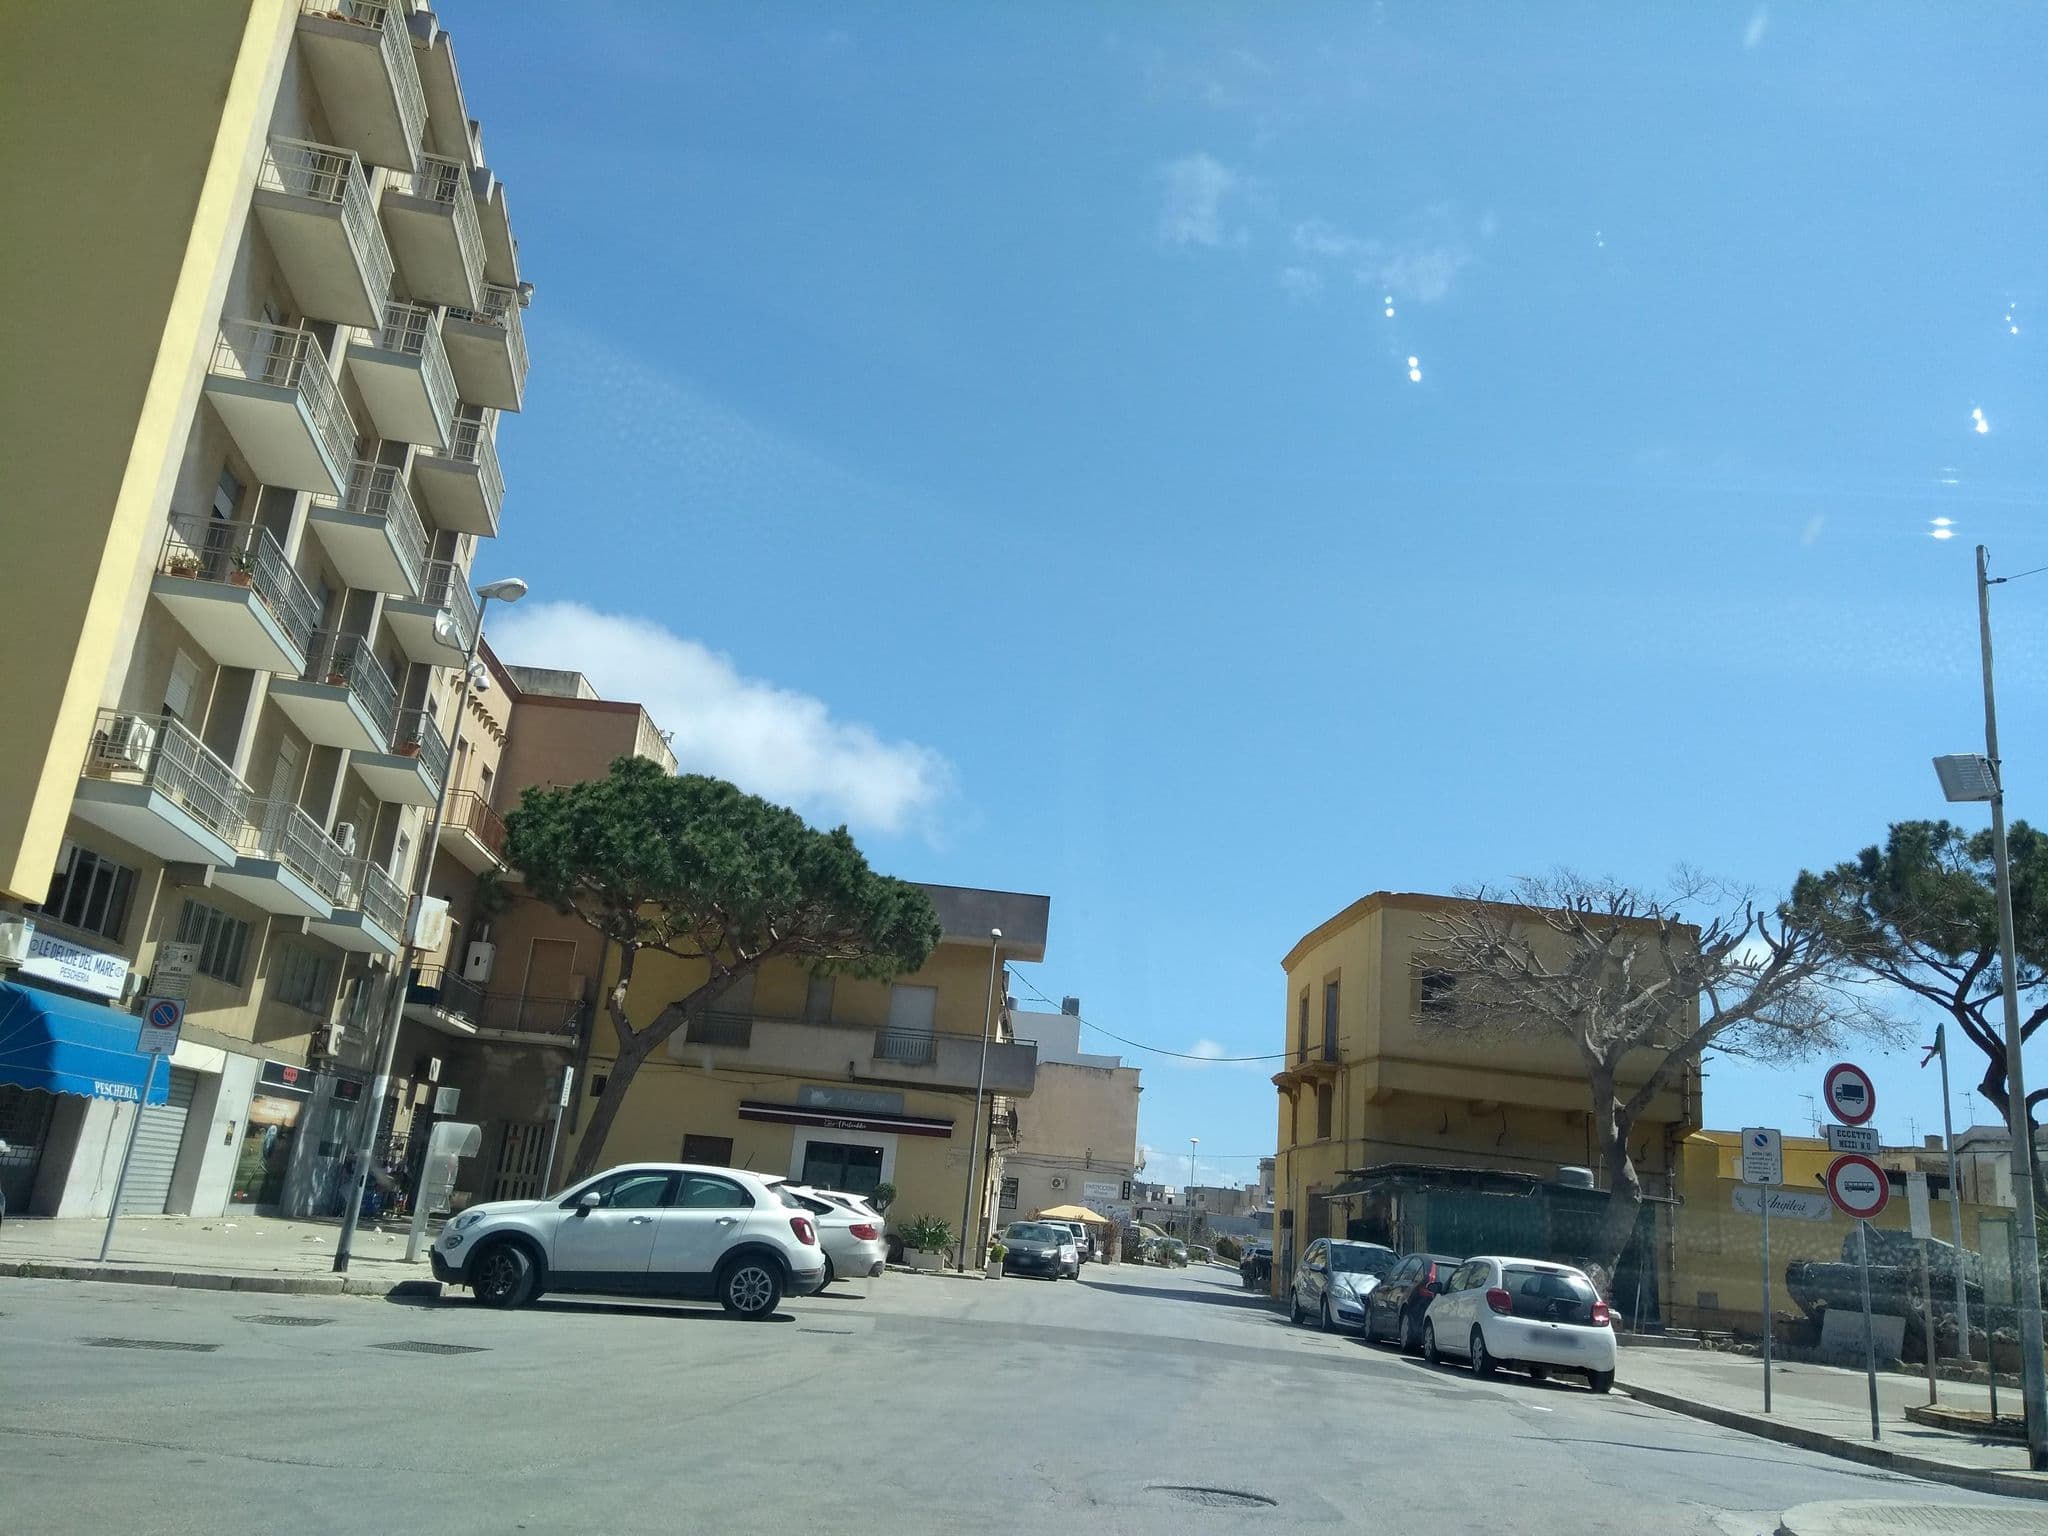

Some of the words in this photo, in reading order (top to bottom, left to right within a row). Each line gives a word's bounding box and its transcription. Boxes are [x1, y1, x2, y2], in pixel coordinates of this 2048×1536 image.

[39, 939, 51, 957] LE
[49, 943, 80, 966] DELIZIE
[79, 952, 92, 971] DEL
[93, 958, 116, 977] MARE
[60, 967, 90, 982] PESCHERIA
[94, 1081, 139, 1100] PESCHERIA
[1836, 1129, 1872, 1140] ECCETTO
[1838, 1140, 1858, 1149] MEZZI
